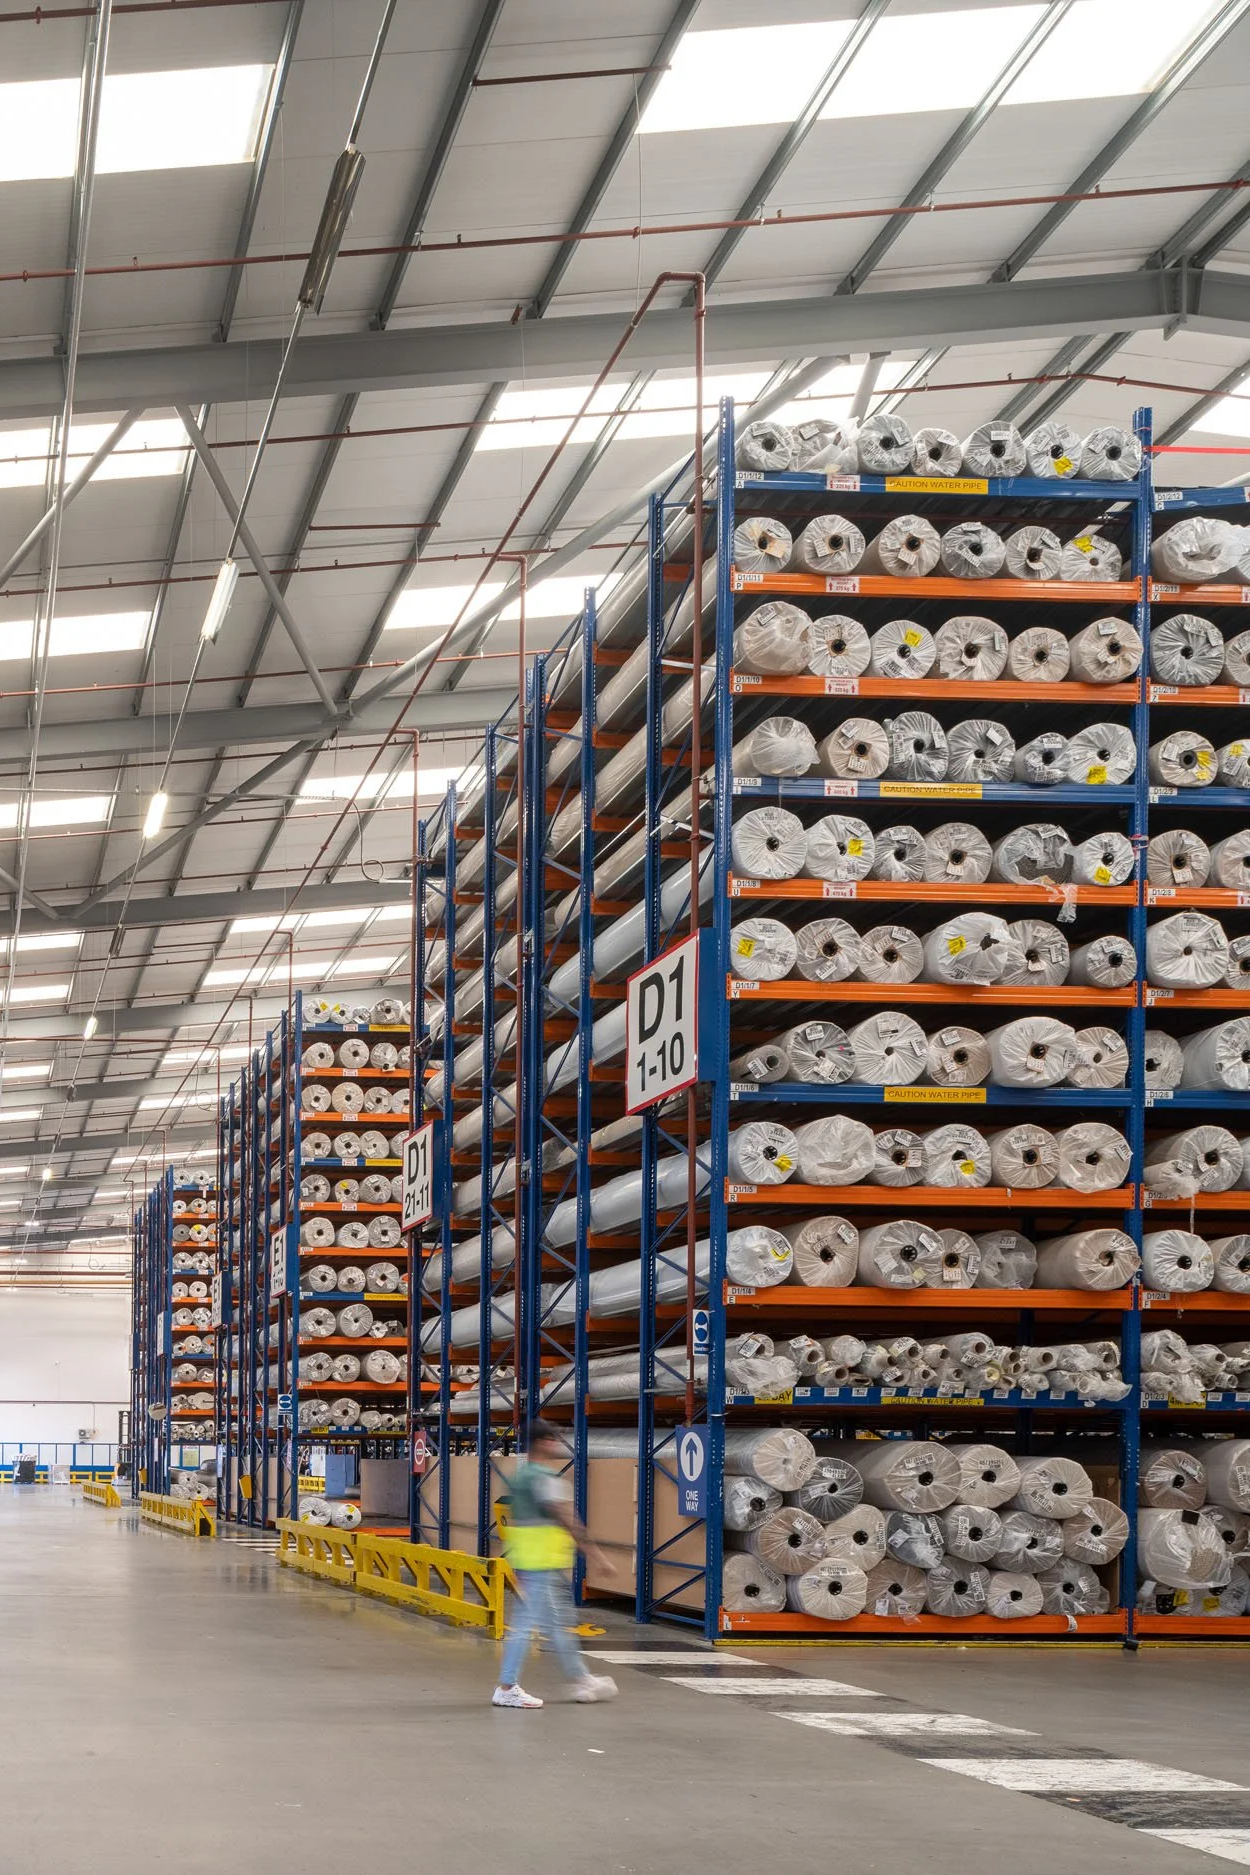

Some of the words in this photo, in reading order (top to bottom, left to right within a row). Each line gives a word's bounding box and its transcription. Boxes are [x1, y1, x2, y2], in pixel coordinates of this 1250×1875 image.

[889, 480, 928, 488] CAUTION
[931, 481, 961, 489] WATER
[962, 482, 982, 490] PIPE
[884, 785, 922, 793] CAUTION
[925, 786, 955, 794] WATER
[639, 955, 685, 1044] D1
[637, 1031, 685, 1092] 1-10
[888, 1090, 926, 1098] CAUTION
[929, 1091, 959, 1099] WATER
[407, 1134, 427, 1186] D1
[404, 1181, 429, 1220] 21-11
[730, 1194, 736, 1202] R
[274, 1233, 284, 1267] E1
[685, 1490, 698, 1500] ONE
[685, 1501, 698, 1511] WAY
